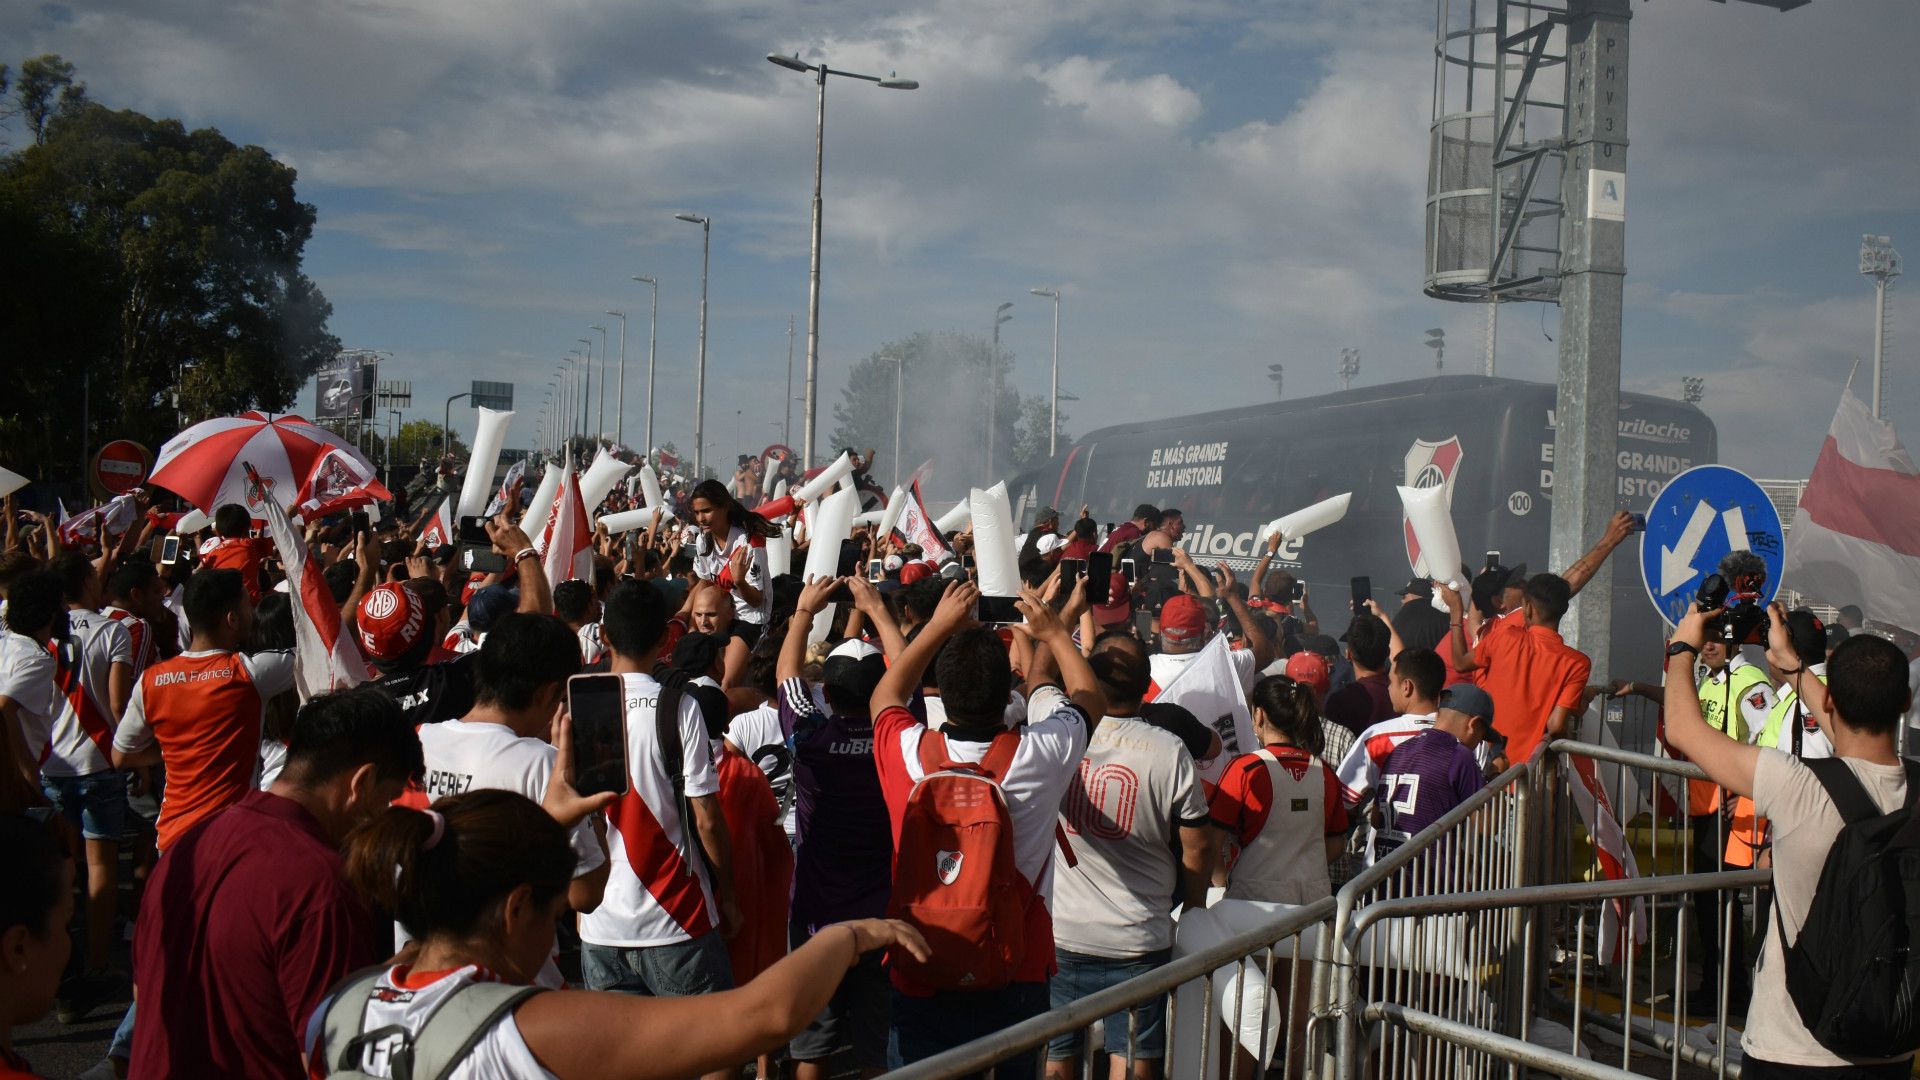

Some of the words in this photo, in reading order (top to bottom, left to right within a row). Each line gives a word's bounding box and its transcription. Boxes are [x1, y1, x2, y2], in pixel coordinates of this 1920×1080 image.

[1602, 179, 1618, 201] A
[1151, 449, 1162, 467] EL
[1162, 440, 1184, 465] MÁS
[1147, 471, 1158, 488] DE
[1160, 468, 1173, 488] LA
[1174, 466, 1222, 486] HISTORIA
[1510, 495, 1530, 511] 100
[1173, 524, 1304, 561] riloche
[154, 671, 187, 687] BBVA
[1066, 757, 1140, 840] 10
